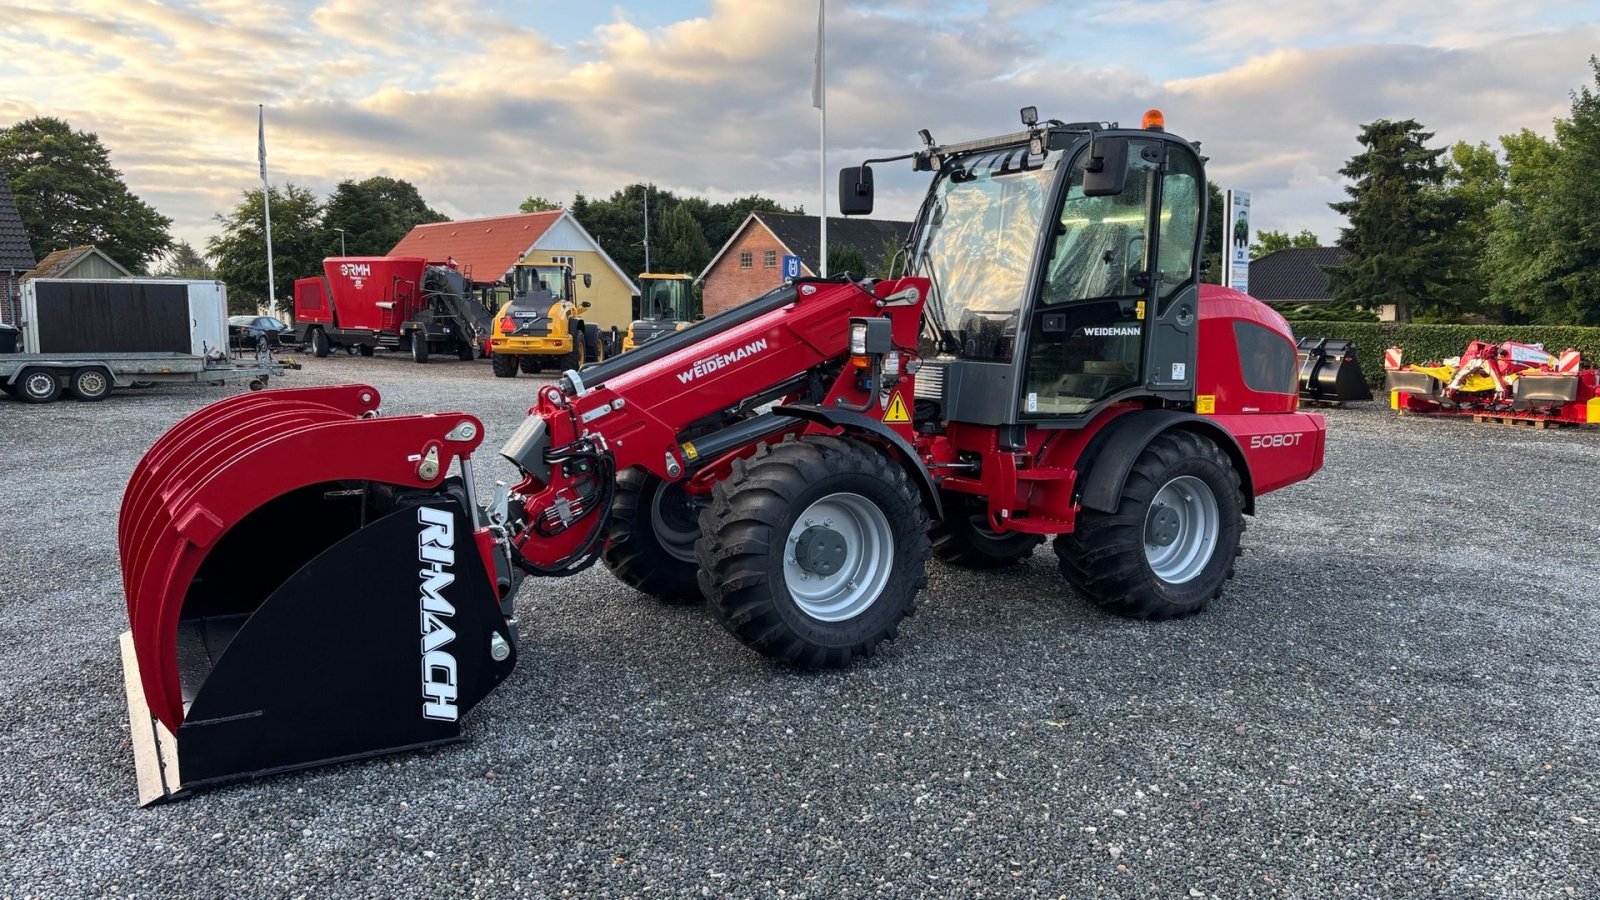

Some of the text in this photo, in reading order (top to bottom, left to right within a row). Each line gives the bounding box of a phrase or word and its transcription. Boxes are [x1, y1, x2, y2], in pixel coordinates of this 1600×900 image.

[1083, 327, 1141, 336] WEIDEMANN
[676, 338, 768, 384] WEIDEMANN
[1250, 433, 1303, 449] 5080T
[418, 506, 458, 722] RI-MACH
